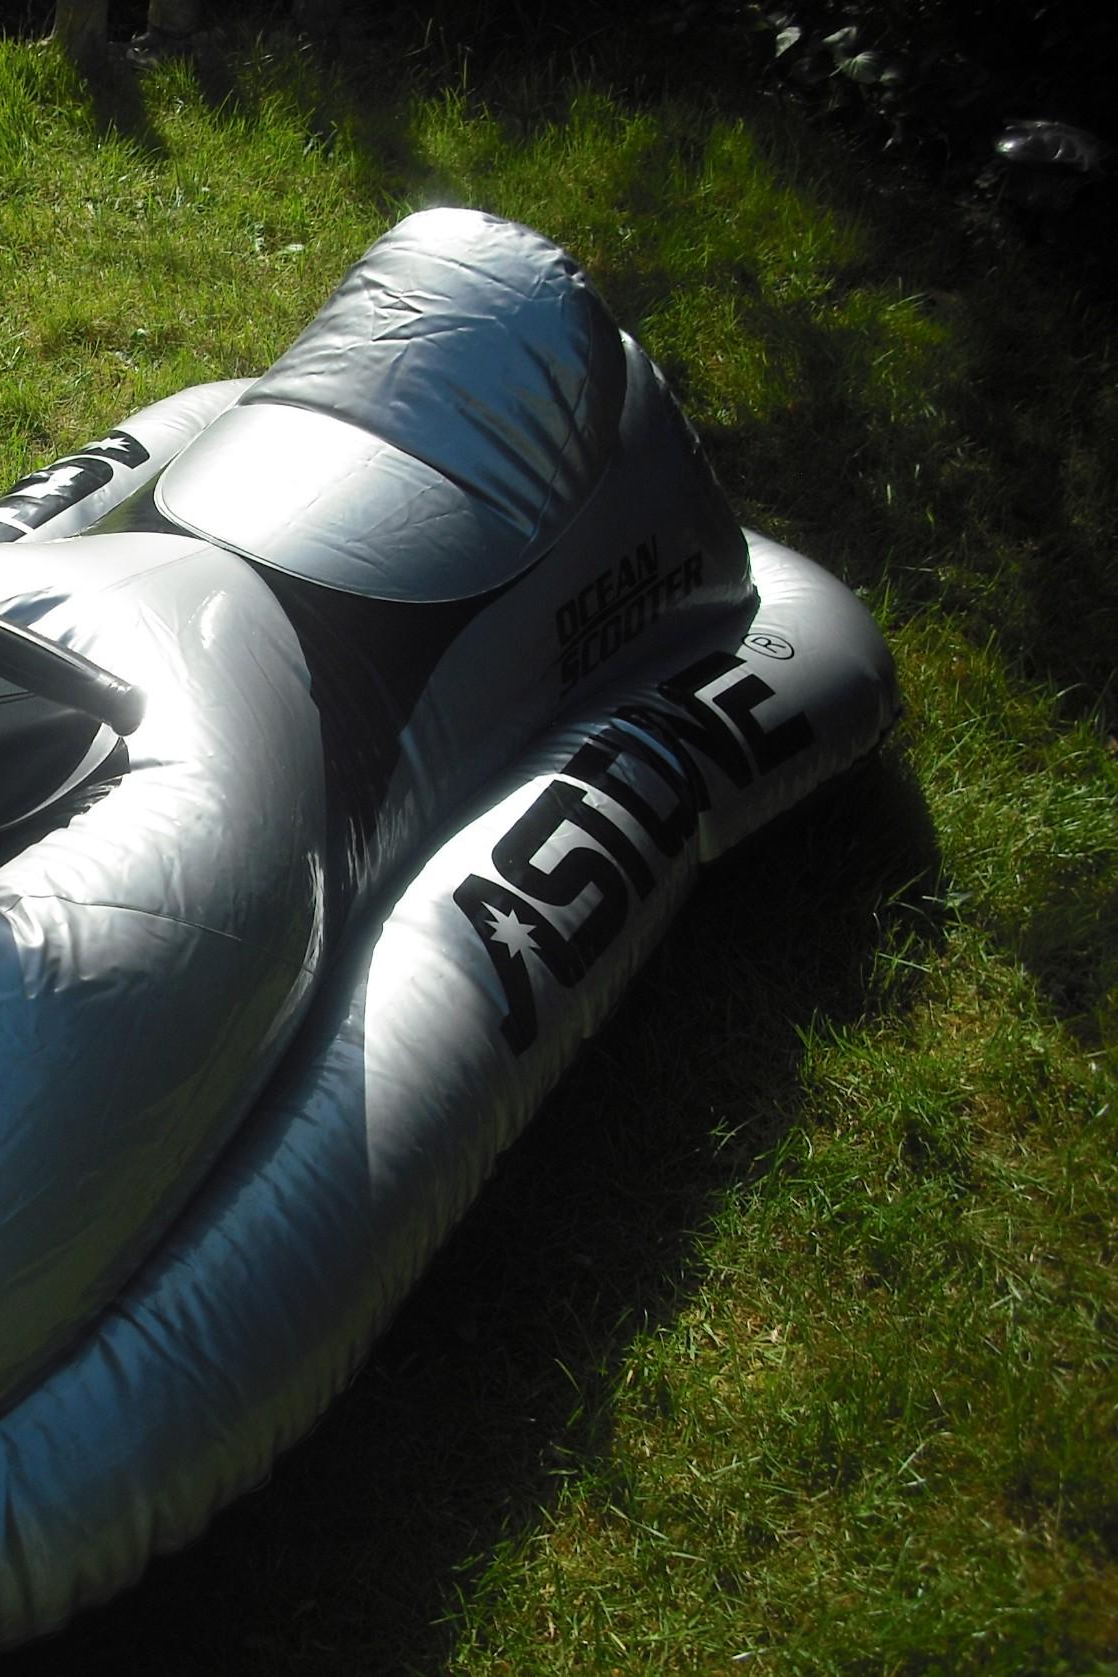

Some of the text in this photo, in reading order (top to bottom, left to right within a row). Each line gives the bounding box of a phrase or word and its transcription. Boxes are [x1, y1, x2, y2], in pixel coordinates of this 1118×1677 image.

[555, 534, 659, 645] OCEAN
[559, 551, 703, 696] SCOOTER
[453, 650, 816, 1058] ASTONE
